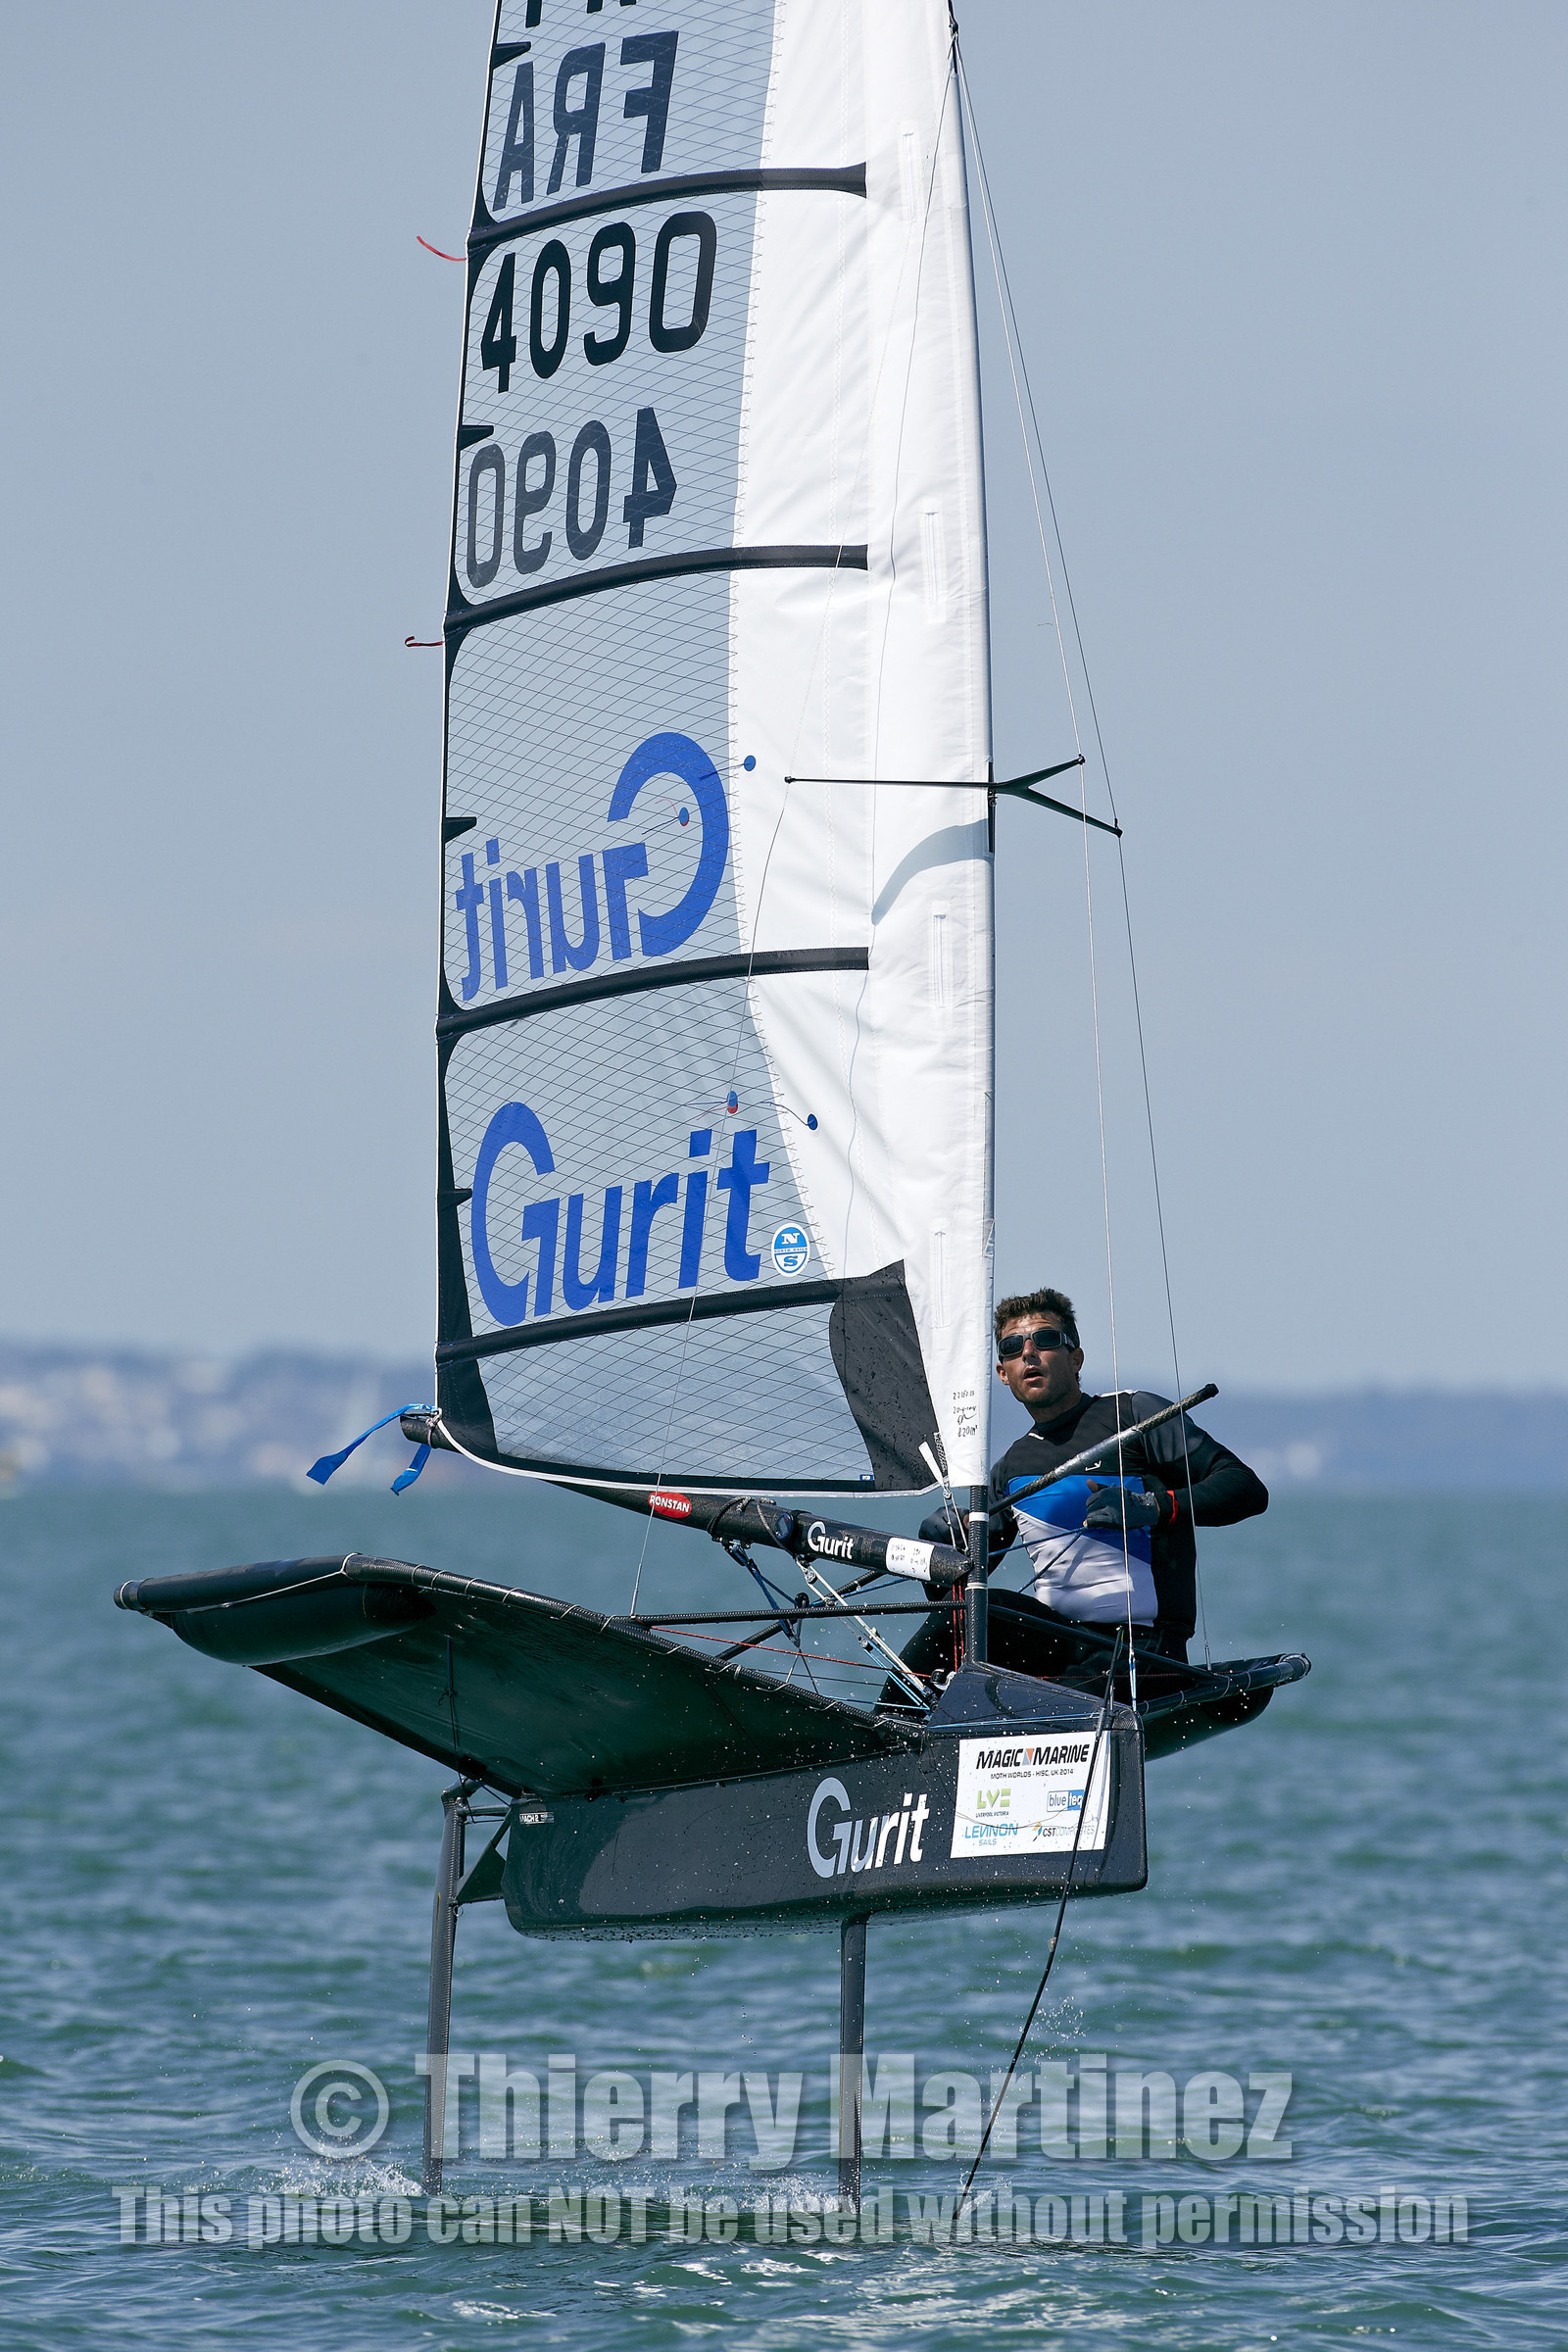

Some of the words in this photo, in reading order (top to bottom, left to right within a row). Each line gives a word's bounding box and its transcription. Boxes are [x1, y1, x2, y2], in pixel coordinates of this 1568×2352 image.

[480, 211, 717, 393] 4090
[471, 1102, 770, 1327] Gurit
[649, 1494, 690, 1513] RONSTAN
[808, 1521, 854, 1559] Gurit
[976, 1748, 1023, 1770] MAGIC
[1033, 1743, 1090, 1766] MARINE
[1007, 1770, 1032, 1779] WORLDS
[807, 1777, 930, 1879] Gurit
[964, 1823, 1018, 1839] LENNON
